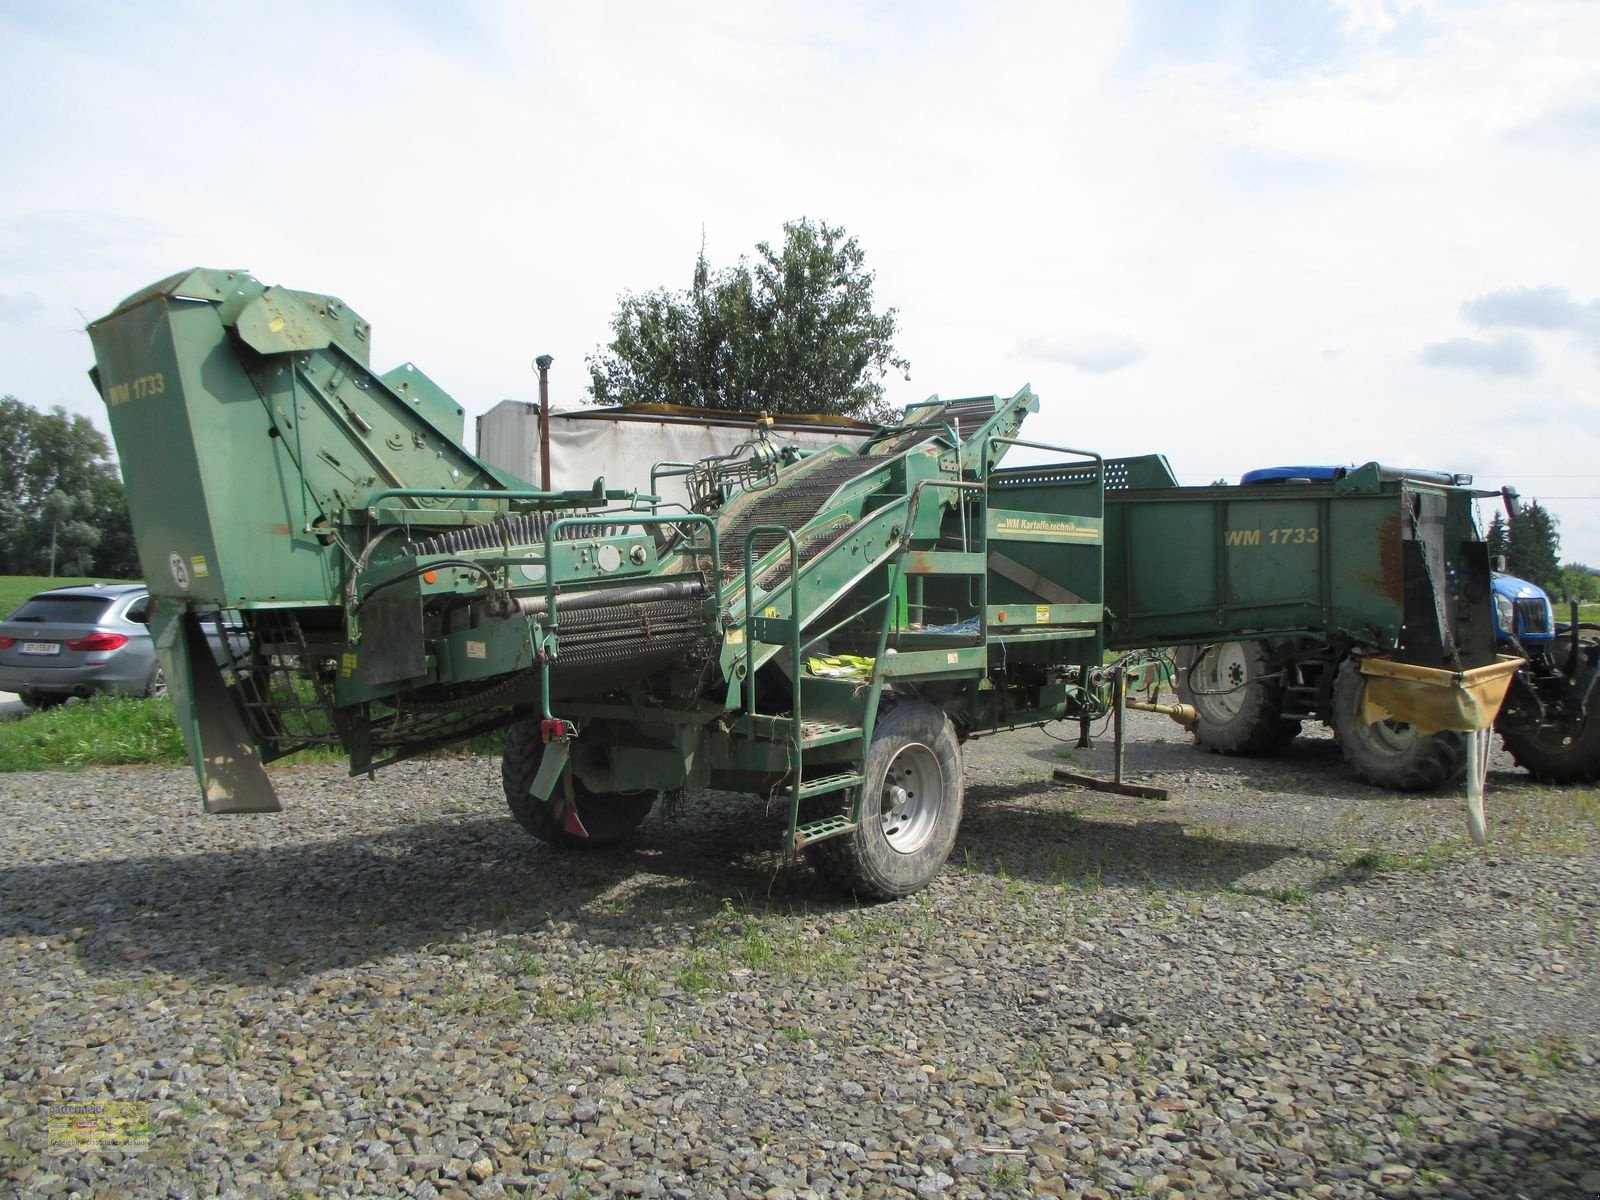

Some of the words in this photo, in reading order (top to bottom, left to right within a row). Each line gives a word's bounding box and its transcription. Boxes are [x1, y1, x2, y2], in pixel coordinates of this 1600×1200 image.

[108, 383, 130, 407] WM
[134, 373, 165, 400] 1733
[1006, 518, 1019, 529] WM
[1020, 519, 1077, 532] Kartoffetechnik
[1224, 529, 1261, 546] WM
[1268, 528, 1320, 545] 1733
[172, 558, 187, 583] 25
